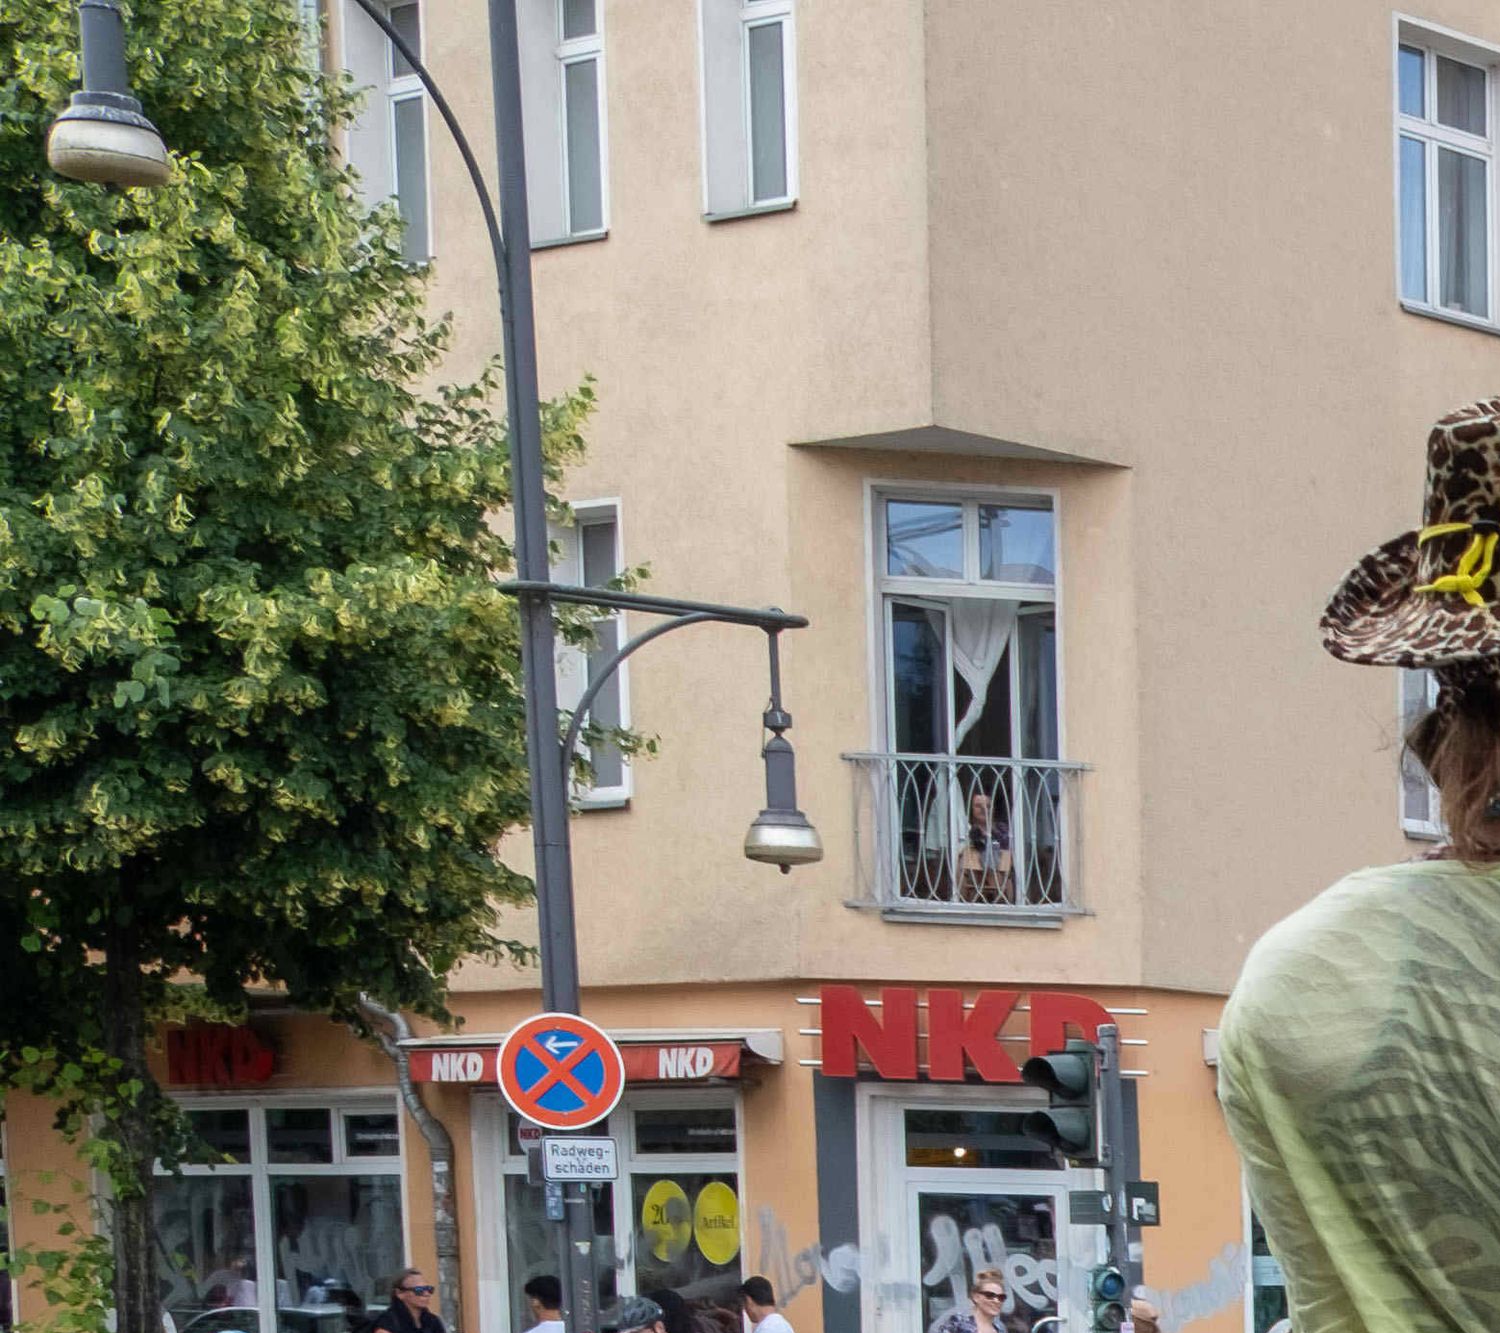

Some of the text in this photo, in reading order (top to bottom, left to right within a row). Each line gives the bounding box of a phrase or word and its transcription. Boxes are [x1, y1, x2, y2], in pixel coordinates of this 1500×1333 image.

[431, 1053, 483, 1081] NKD
[659, 1047, 714, 1079] NKD
[520, 1128, 542, 1139] NKD
[551, 1144, 610, 1159] Radweg-
